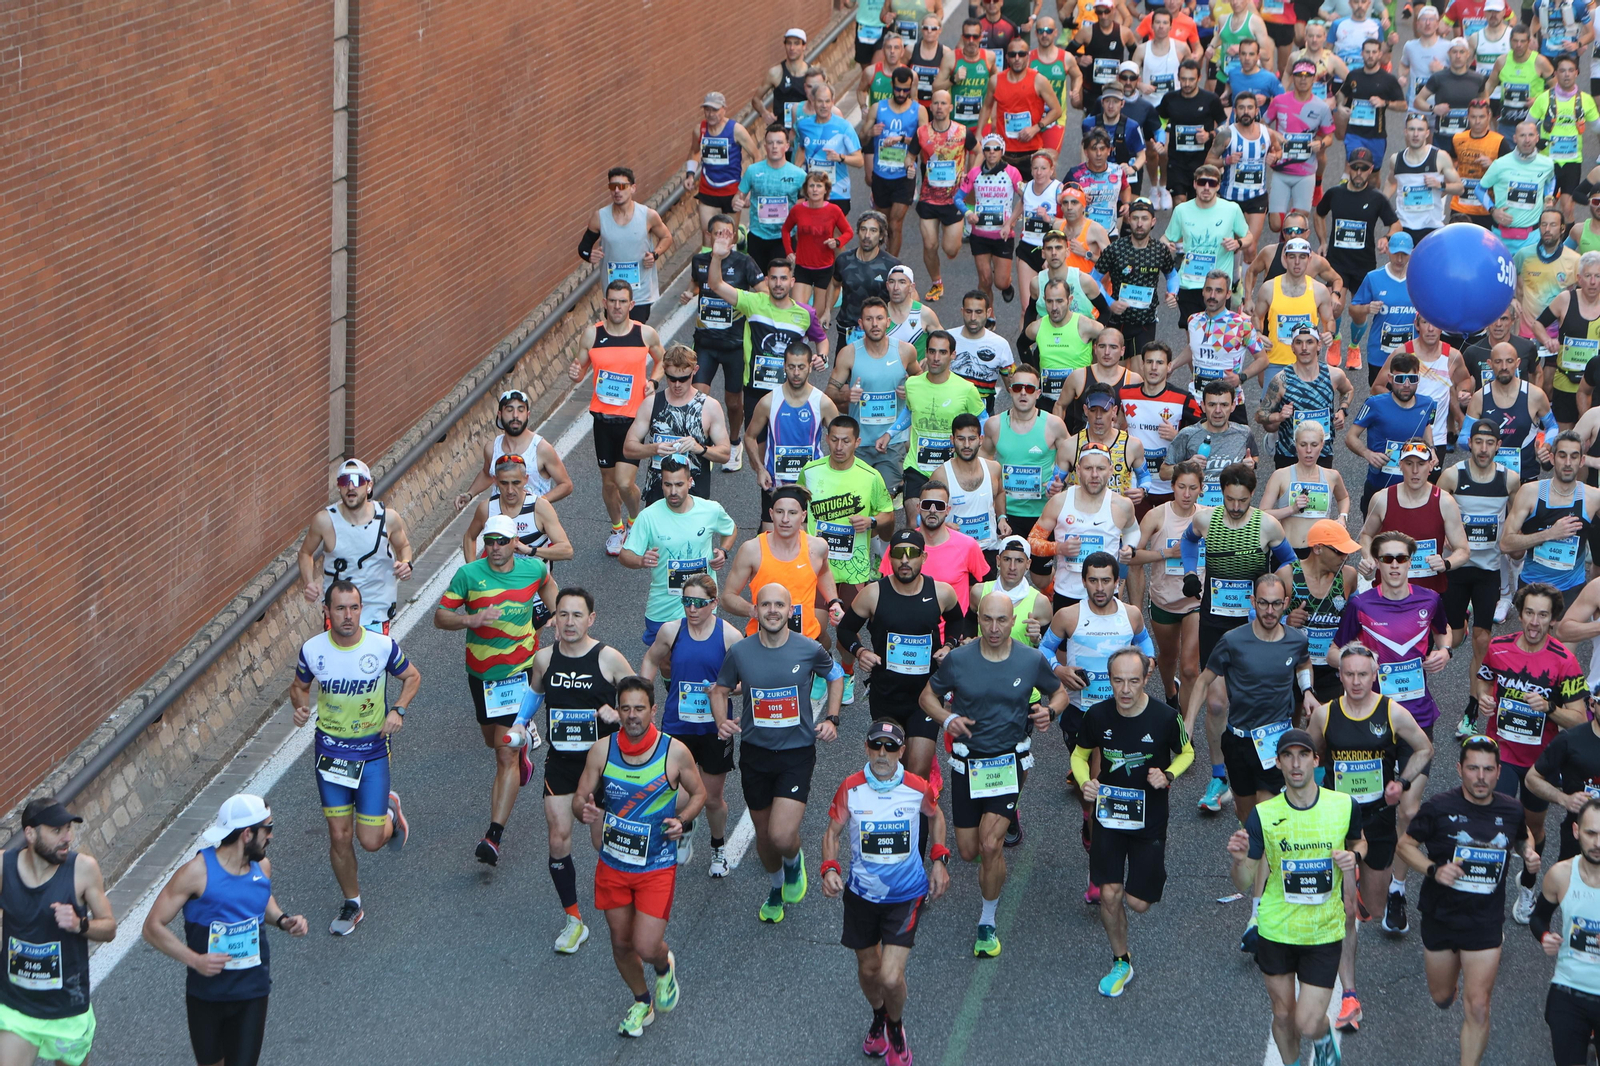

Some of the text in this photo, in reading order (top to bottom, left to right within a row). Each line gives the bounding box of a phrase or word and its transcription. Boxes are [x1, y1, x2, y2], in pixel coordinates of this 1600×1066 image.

[812, 138, 838, 146] ZURICH
[1201, 369, 1220, 377] ZURICH
[609, 374, 629, 382] ZURICH
[1306, 410, 1327, 419] ZURICH
[1143, 449, 1163, 457] ZURICH
[1303, 484, 1325, 492] ZURICH
[811, 494, 855, 516] TORTUGAS
[965, 516, 986, 525] ZURICH
[1472, 515, 1495, 523] ZURICH
[829, 525, 851, 534] ZURICH
[682, 560, 704, 568] ZURICH
[1224, 582, 1248, 590] ZURICH
[1310, 630, 1333, 638] ZURICH
[903, 637, 927, 645] ZURICH
[902, 650, 917, 658] 4680
[1394, 661, 1418, 672] ZURICH
[500, 677, 523, 687] ZURICH
[550, 675, 593, 690] Uglow
[1394, 677, 1410, 685] 6068
[1496, 673, 1553, 699] RUNNERS
[766, 689, 792, 698] ZURICH
[768, 704, 783, 712] 1015
[565, 712, 591, 720] ZURICH
[1267, 722, 1290, 735] ZURICH
[1504, 724, 1534, 736] GUILLERMO
[566, 734, 582, 742] DAVID
[984, 757, 1010, 767] ZURICH
[1350, 762, 1376, 771] ZURICH
[1351, 777, 1367, 785] 1575
[1113, 789, 1139, 799] ZURICH
[1351, 786, 1368, 794] PADDY
[1111, 812, 1130, 820] JAVIER
[618, 821, 644, 834] ZURICH
[877, 822, 905, 831] ZURICH
[608, 841, 629, 854] ROBERTO
[1293, 840, 1333, 852] Running
[879, 847, 893, 855] LUIS
[1472, 851, 1500, 861] ZURICH
[1298, 861, 1327, 870] ZURICH
[1300, 886, 1318, 894] NICKY
[228, 922, 255, 935] ZURICH
[24, 946, 53, 956] ZURICH
